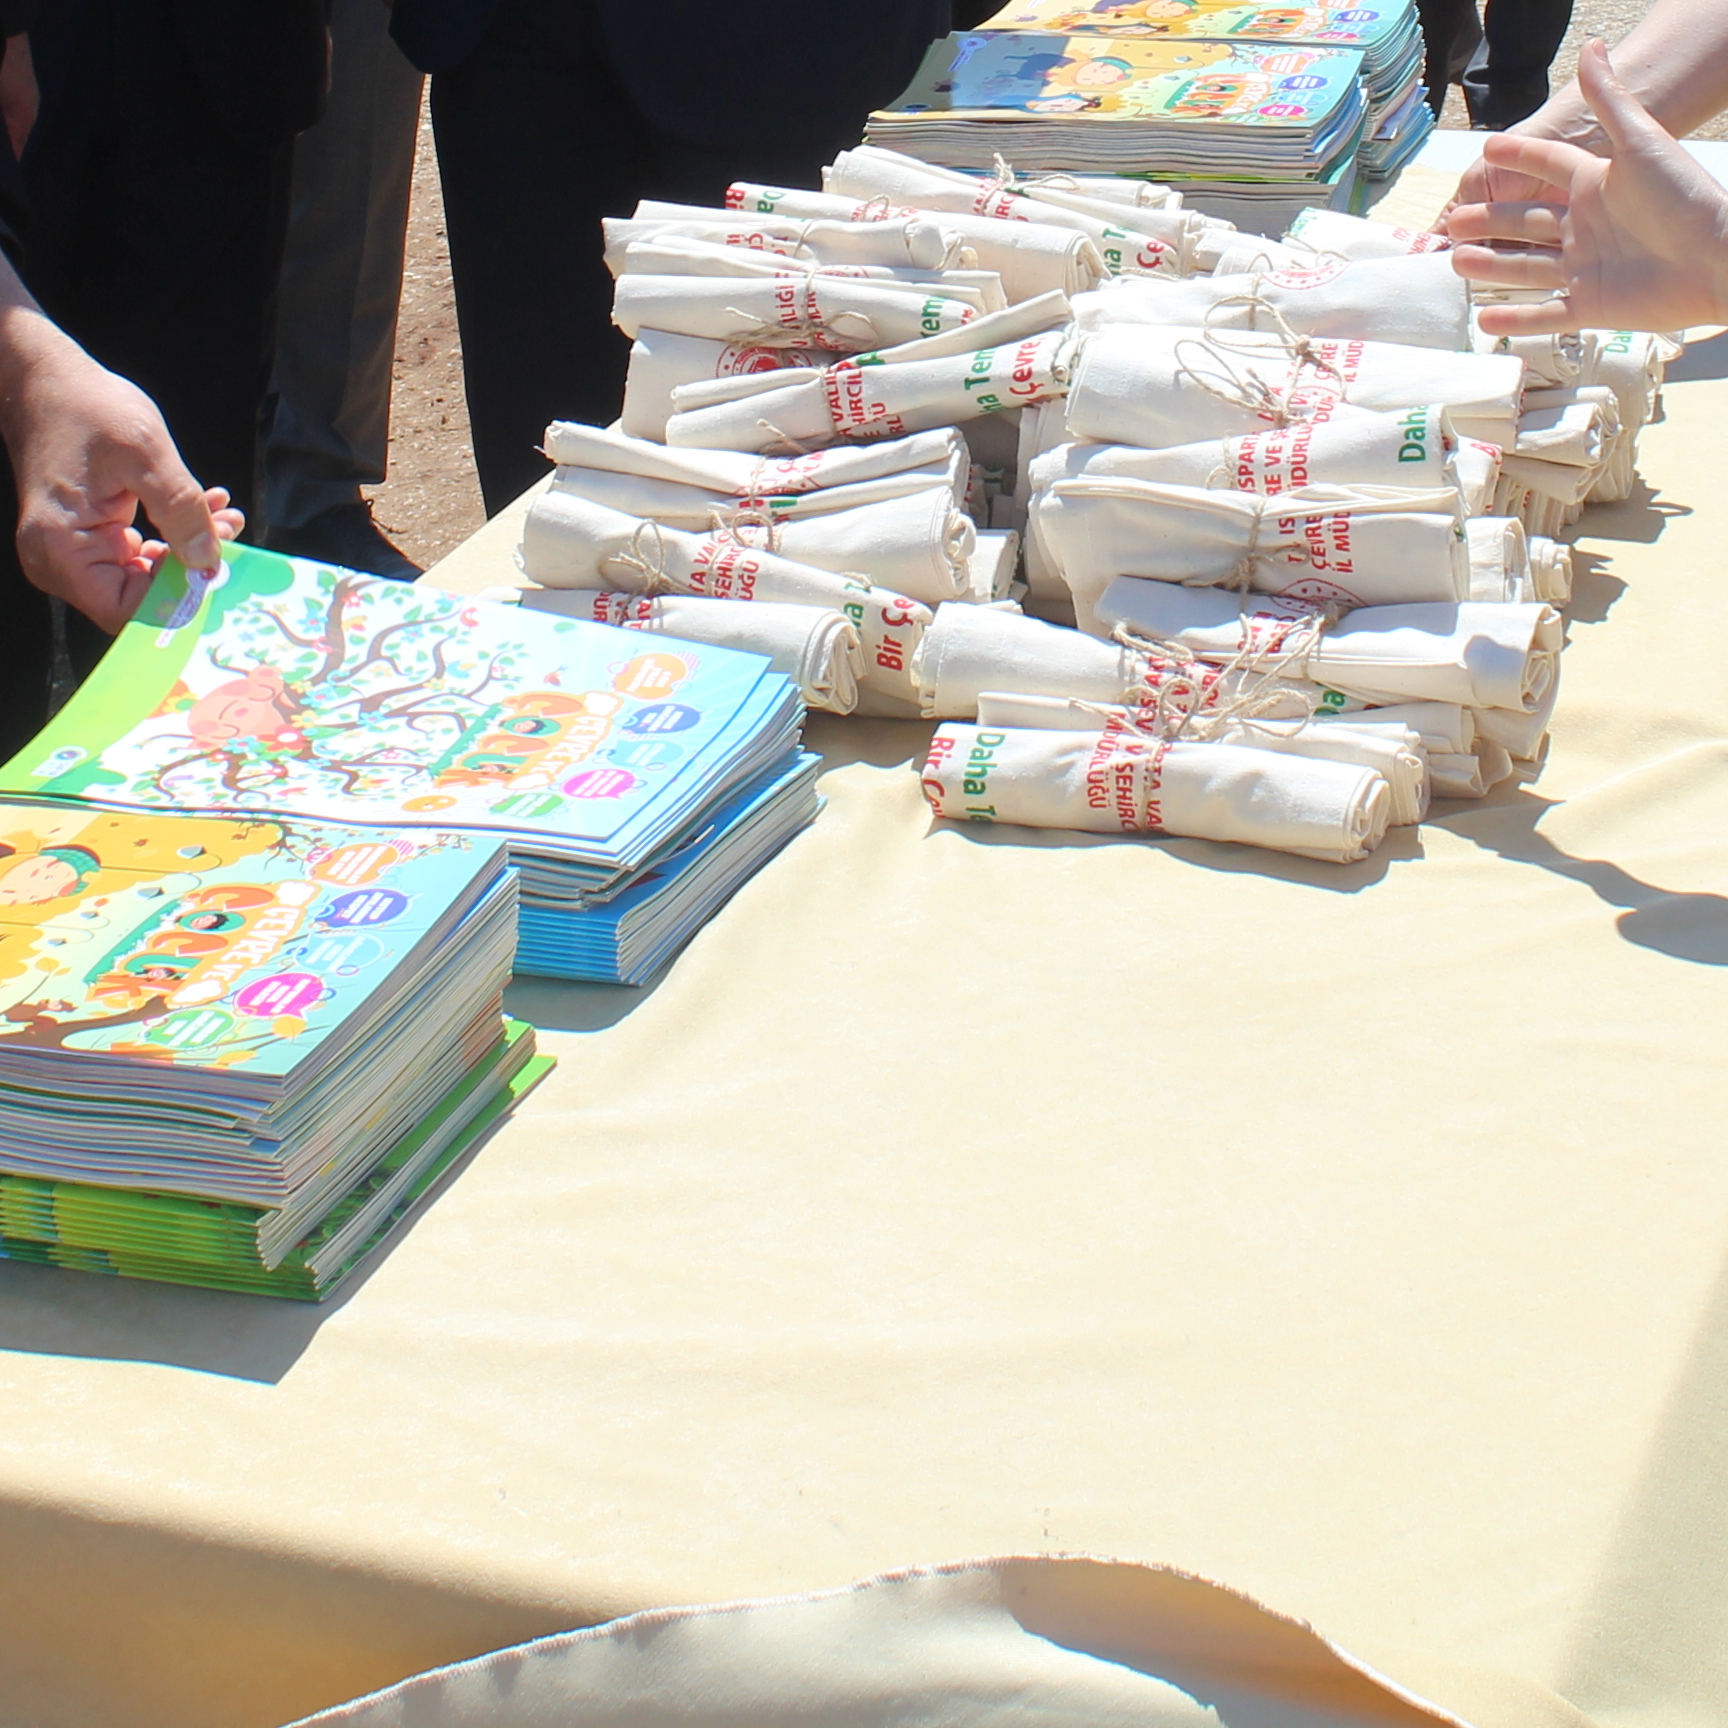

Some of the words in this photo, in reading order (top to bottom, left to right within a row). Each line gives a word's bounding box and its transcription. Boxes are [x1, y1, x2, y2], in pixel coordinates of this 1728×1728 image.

[1332, 558, 1354, 573] İL
[875, 634, 904, 672] Bir
[439, 693, 585, 788] ÇOCUK
[540, 716, 609, 760] ÇEVRE
[527, 759, 561, 774] VE
[963, 732, 1006, 796] Daha
[90, 885, 277, 997] ÇOCUK
[216, 908, 303, 965] ÇEVRE
[199, 965, 243, 982] VE
